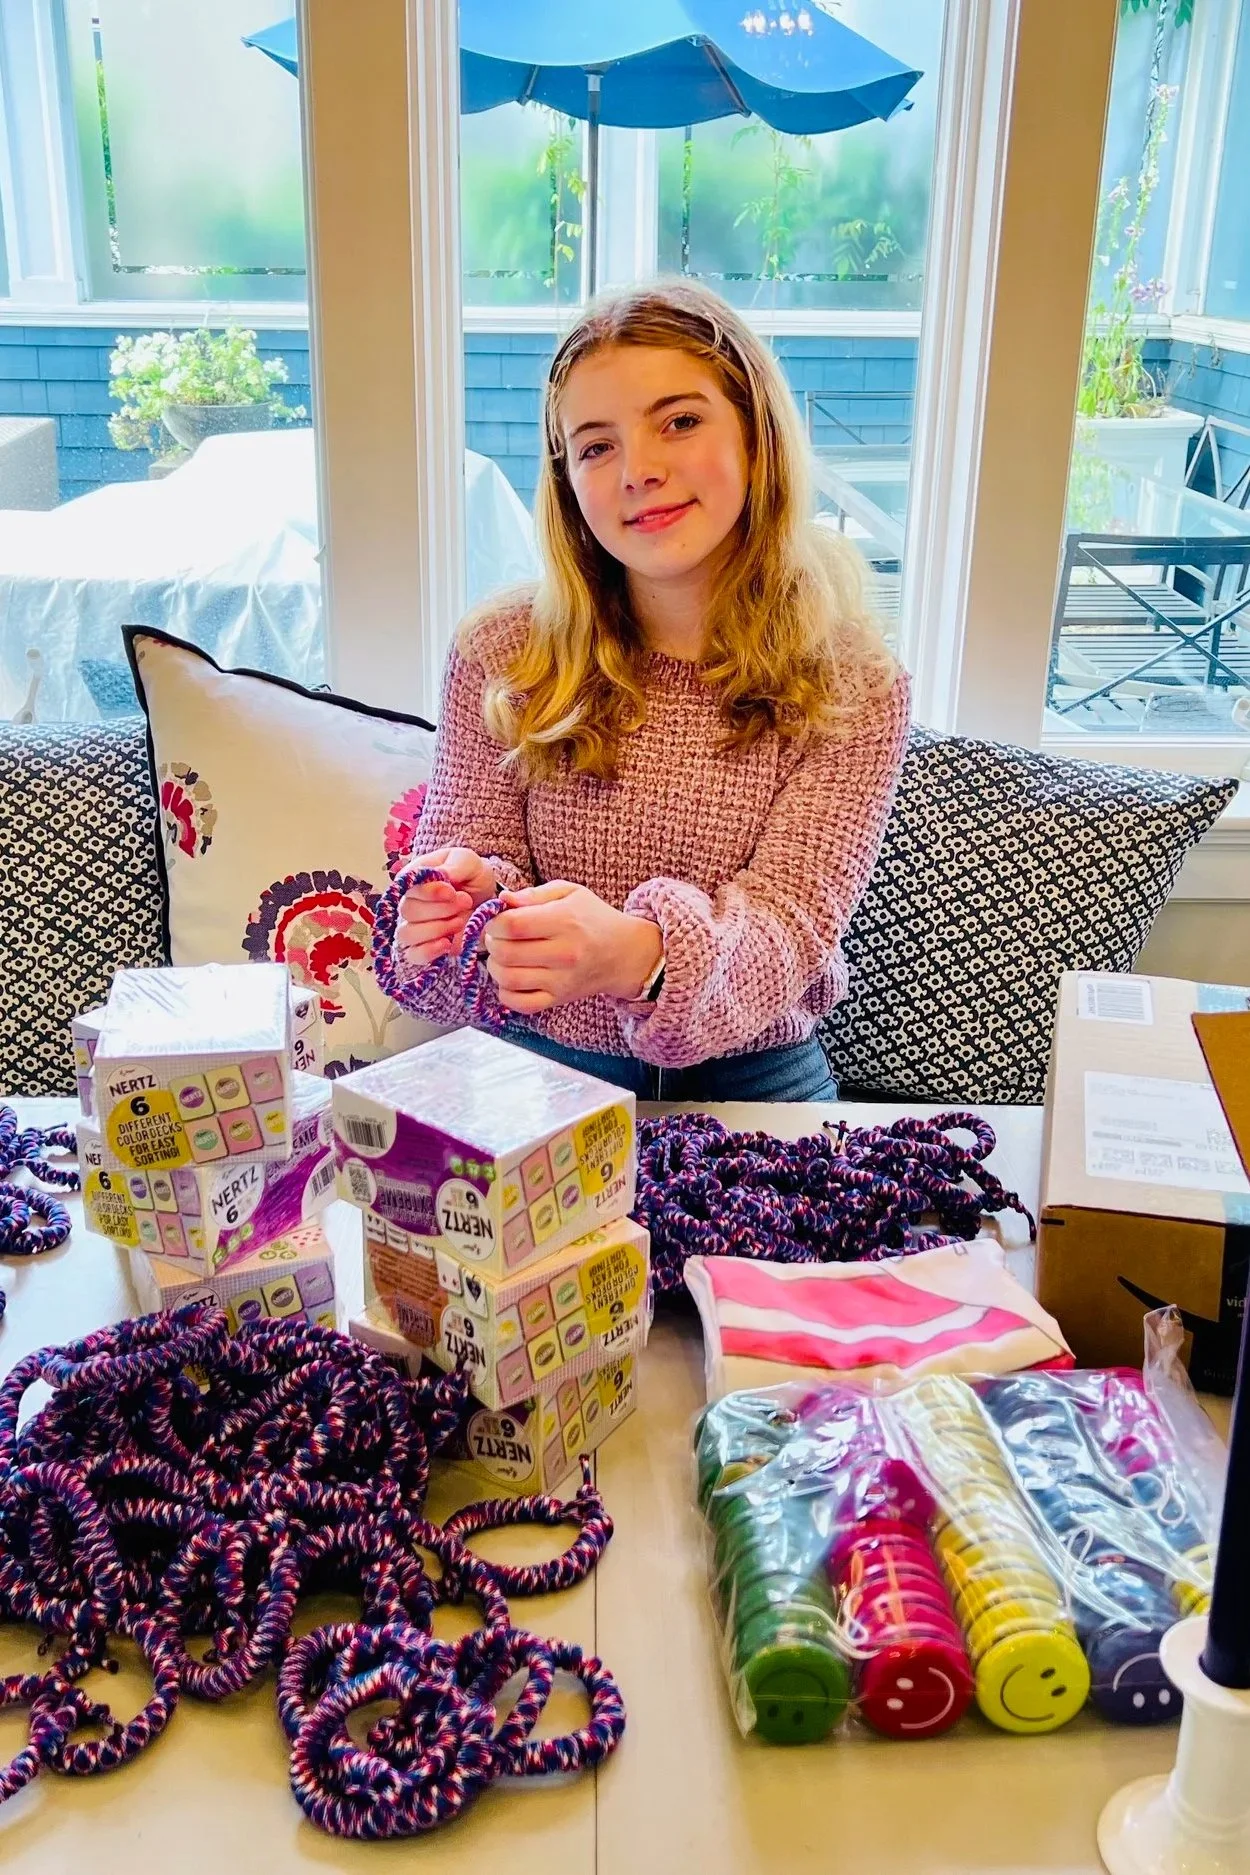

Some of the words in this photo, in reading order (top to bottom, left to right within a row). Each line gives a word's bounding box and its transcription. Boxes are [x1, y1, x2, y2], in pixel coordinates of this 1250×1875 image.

[294, 1039, 304, 1055] 6
[109, 1074, 157, 1098] NERTZ
[130, 1096, 150, 1116] 6
[118, 1111, 172, 1134] DIFFERENT
[130, 1143, 149, 1156] FOR
[151, 1137, 177, 1153] EASY
[134, 1149, 180, 1167] SORTING!
[99, 1171, 111, 1190] 6
[600, 1161, 614, 1184] 6
[211, 1165, 259, 1215] NERTZ
[465, 1190, 479, 1209] 6
[594, 1175, 627, 1209] NERTZ
[226, 1205, 239, 1224] 6
[442, 1208, 494, 1240] NERTZ
[464, 1317, 475, 1338] 6
[602, 1314, 639, 1347] NERTZ
[614, 1370, 624, 1391] 6
[609, 1379, 633, 1416] NERTZ
[500, 1419, 516, 1438] 6
[473, 1435, 532, 1465] NERTZ
